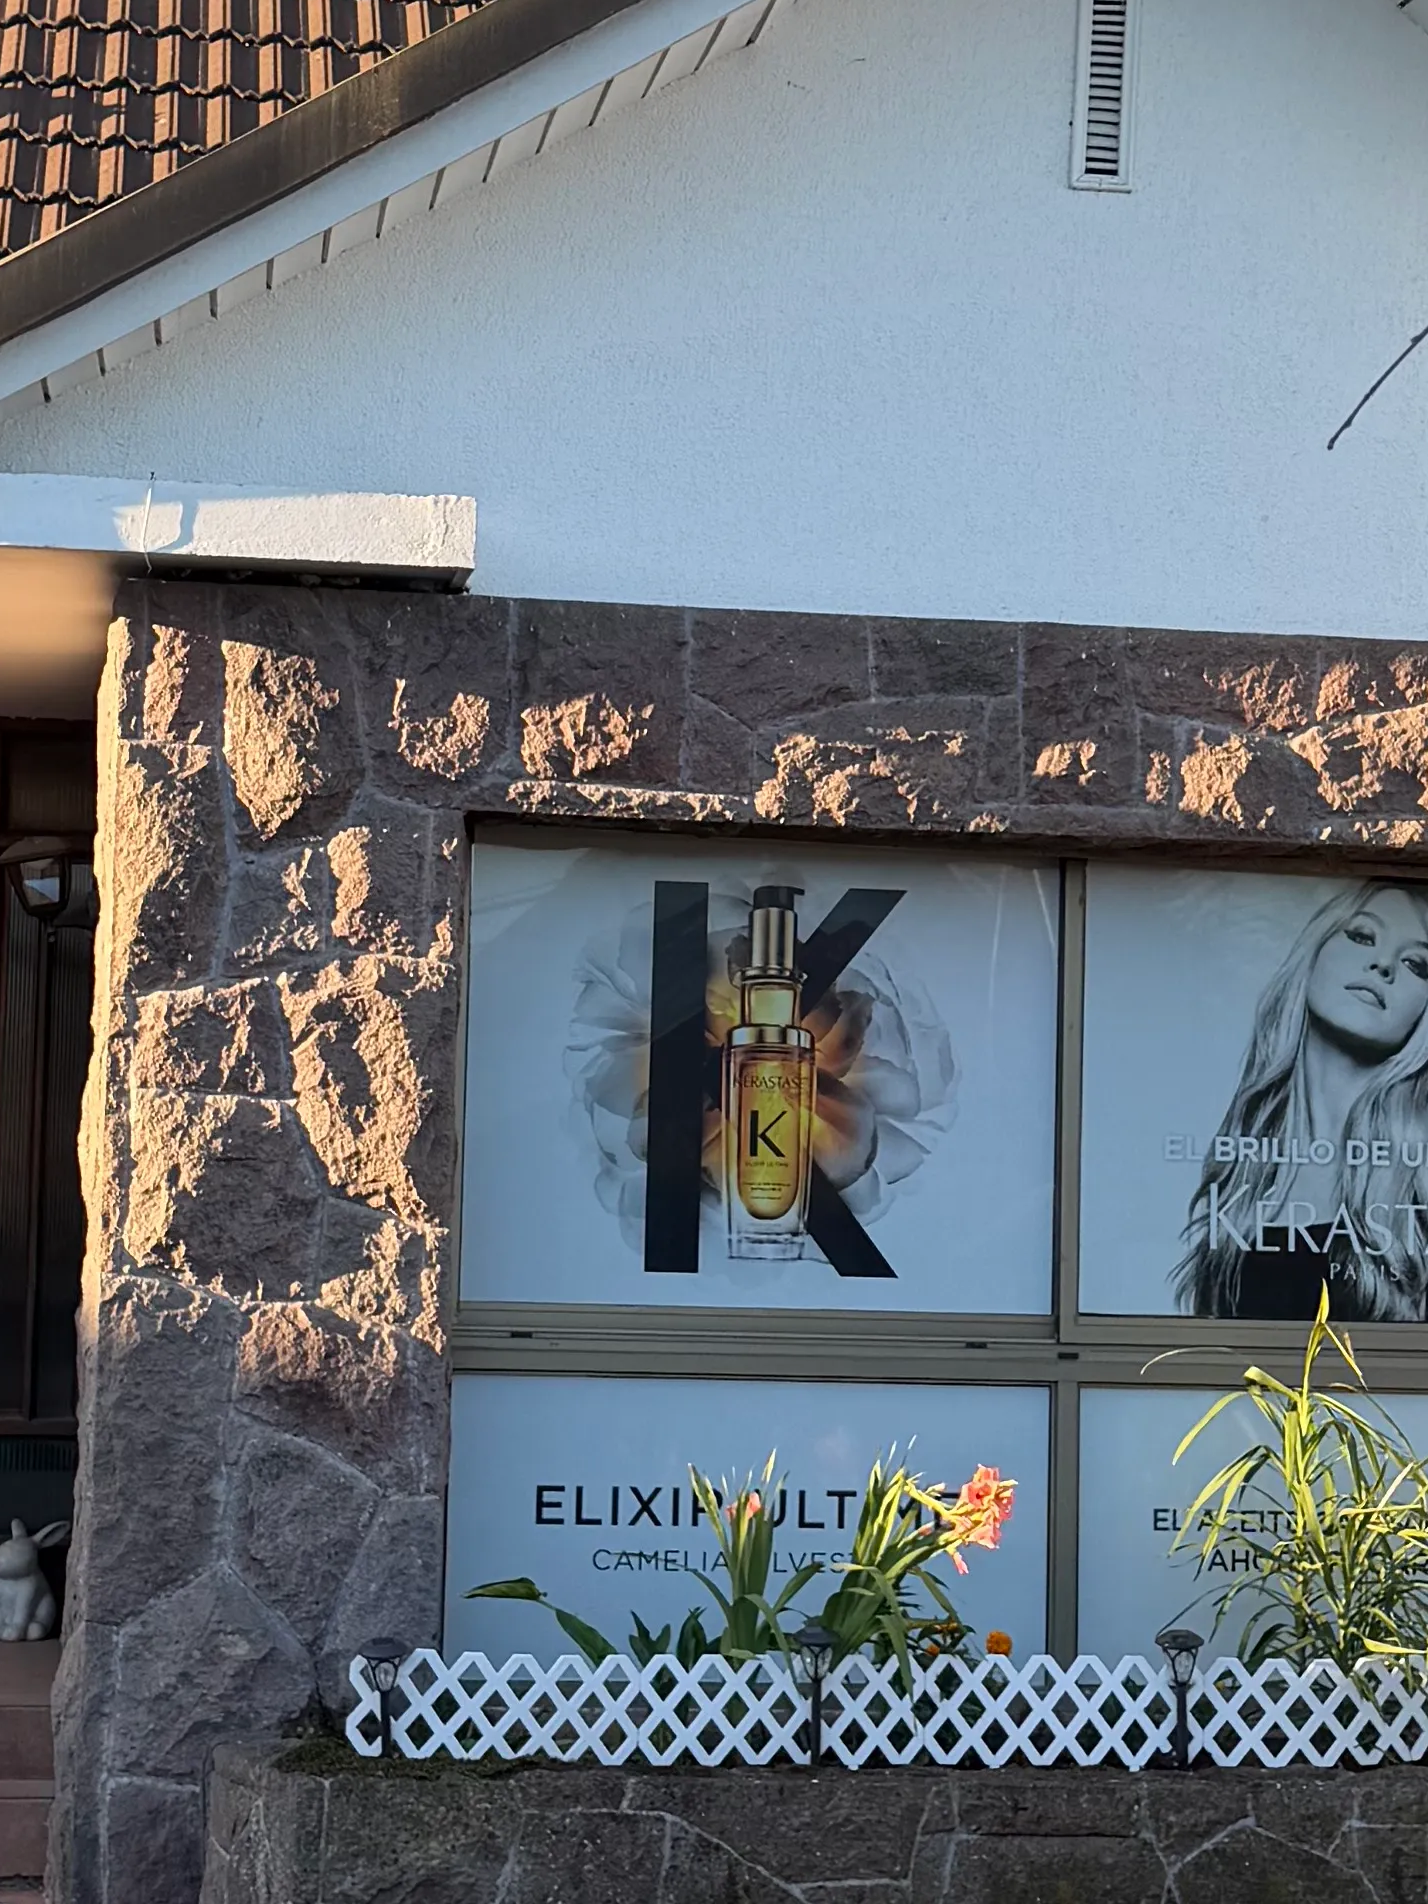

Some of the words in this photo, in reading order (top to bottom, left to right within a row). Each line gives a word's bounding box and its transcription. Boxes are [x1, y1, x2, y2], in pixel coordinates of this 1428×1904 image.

[749, 1109, 788, 1158] K
[1163, 1135, 1204, 1161] EL
[1214, 1135, 1336, 1165] BRILLO
[1346, 1139, 1390, 1167] DE
[1152, 1508, 1182, 1532] EL
[591, 1548, 730, 1572] CAMELIA
